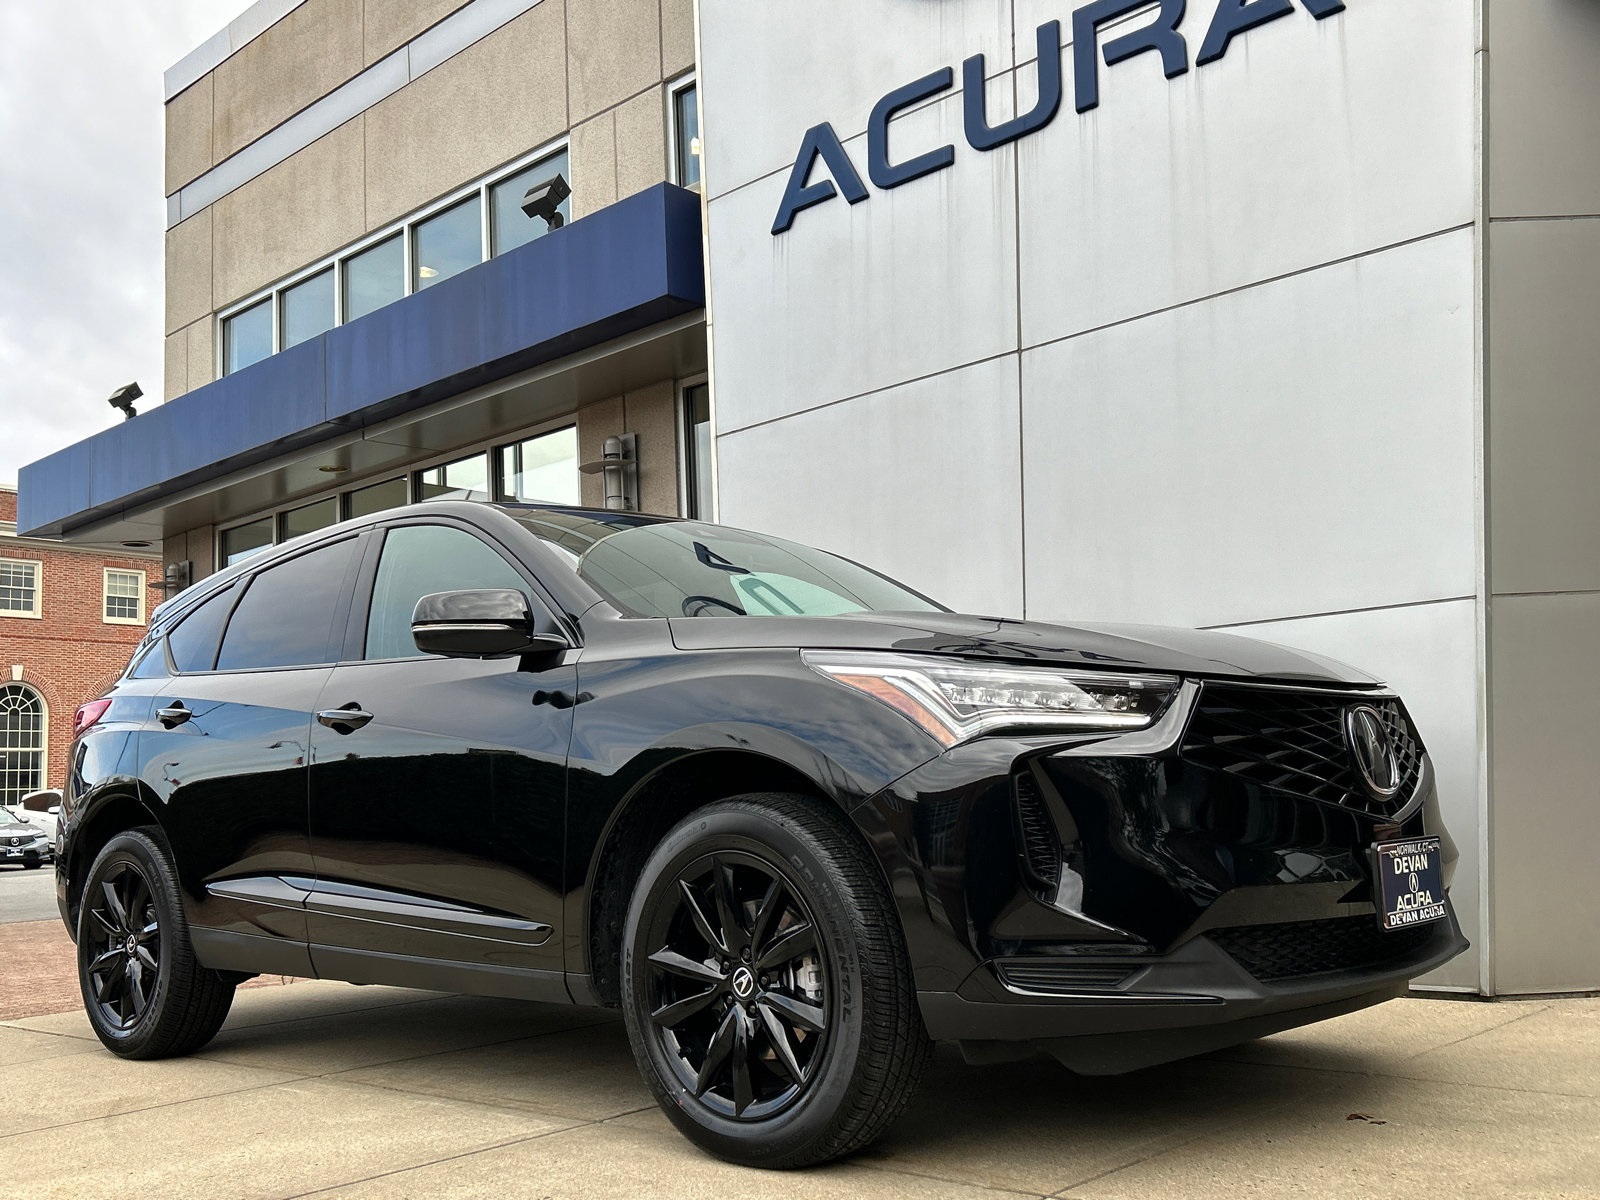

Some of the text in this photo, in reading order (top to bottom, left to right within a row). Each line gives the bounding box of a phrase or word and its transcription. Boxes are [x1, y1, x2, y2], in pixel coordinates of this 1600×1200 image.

[1394, 854, 1428, 875] DEVAN
[1397, 890, 1432, 911] ACURA
[1390, 911, 1418, 926] DEVAN
